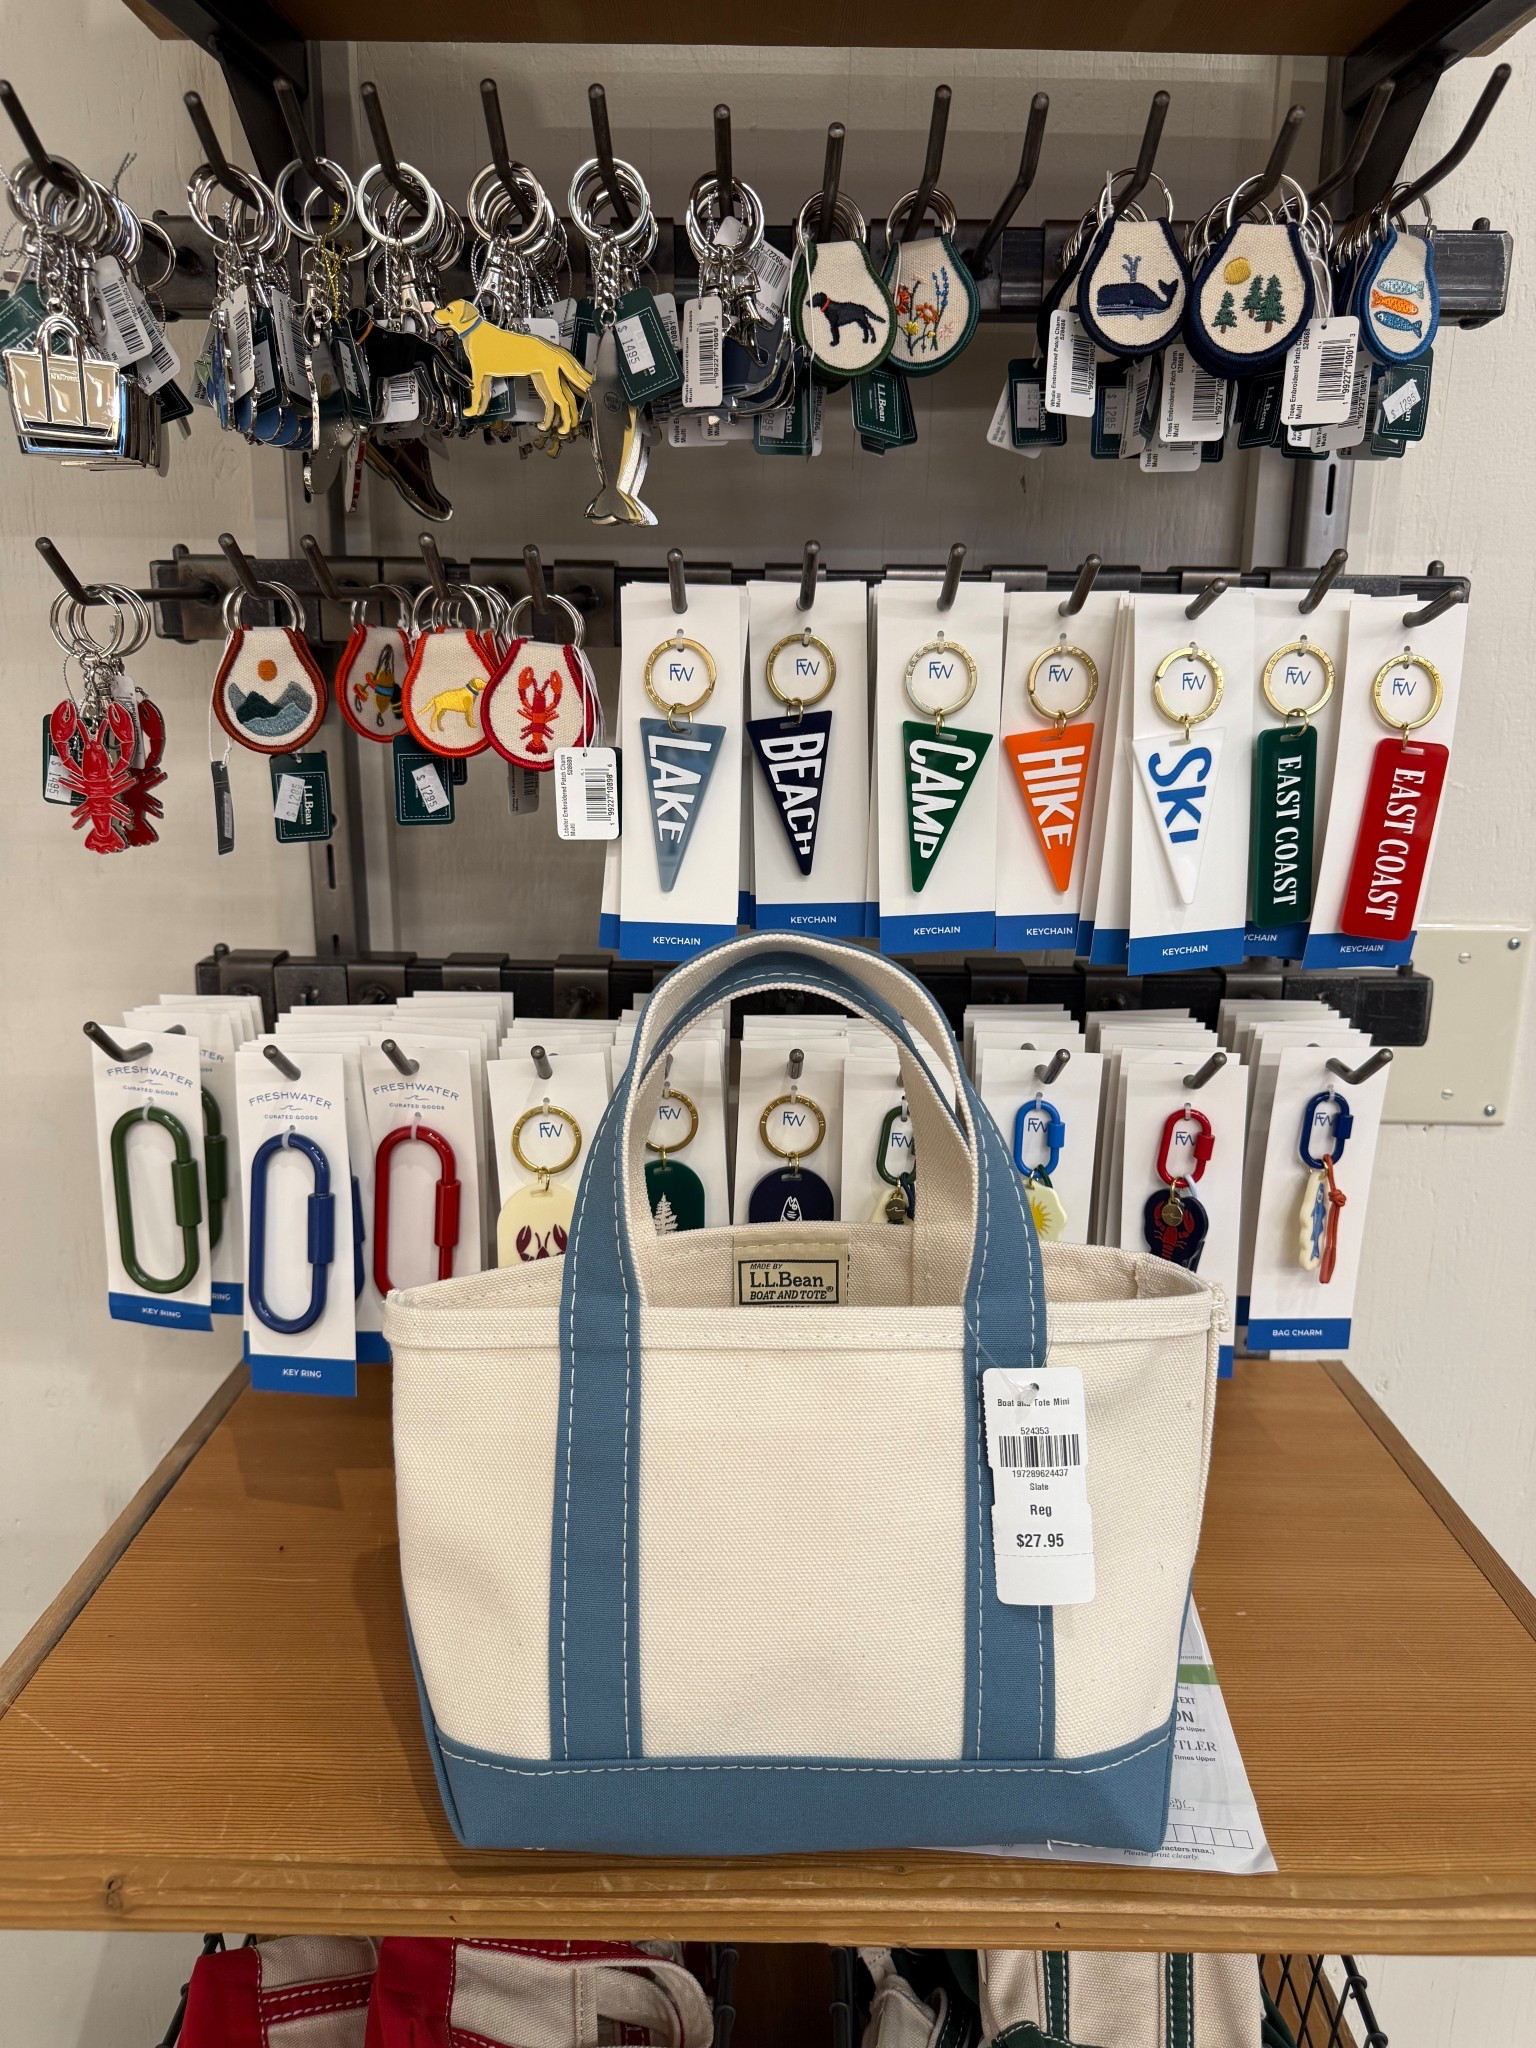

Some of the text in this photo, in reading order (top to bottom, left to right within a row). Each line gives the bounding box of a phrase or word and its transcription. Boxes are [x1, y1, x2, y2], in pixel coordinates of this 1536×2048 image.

[766, 248, 784, 266] 99227
[620, 338, 642, 366] 1495
[1346, 345, 1354, 369] 10901
[1051, 353, 1059, 388] Embroidered
[1087, 367, 1095, 390] 99227
[1290, 365, 1300, 402] Embroidered
[1342, 370, 1352, 394] 99227
[877, 382, 888, 423] L.L.Bean
[1167, 387, 1175, 421] Embroidered
[1215, 393, 1223, 415] 99227
[1287, 403, 1295, 420] Trees
[1295, 404, 1303, 419] Multi
[1356, 397, 1365, 419] 99227
[1400, 392, 1417, 413] 1295
[1105, 405, 1118, 429] 1295
[669, 663, 694, 682] FW
[796, 659, 820, 676] FW
[928, 661, 954, 679] FW
[1048, 664, 1074, 683] FW
[1284, 666, 1311, 685] FW
[1181, 672, 1206, 691] FW
[1392, 678, 1417, 697] FW
[416, 774, 439, 809] $ 1295
[648, 735, 712, 844] LAKE
[760, 733, 824, 855] BEACH
[1017, 745, 1085, 850] HIKE
[1148, 746, 1212, 844] SKI
[304, 785, 313, 825] L.L.Bean
[909, 740, 977, 859] CAMP
[1273, 755, 1302, 905] EAST COAST
[1365, 767, 1426, 921] EAST COAST
[790, 915, 837, 925] KEYCHAIN
[913, 925, 961, 936] KEYCHAIN
[1026, 926, 1073, 937] KEYCHAIN
[1243, 933, 1278, 943] YCHAIN
[652, 936, 701, 946] KEYCHAIN
[1162, 944, 1208, 956] KEYCHAIN
[1340, 944, 1384, 954] KEYCHAIN
[107, 1065, 194, 1088] FRESHWATER
[122, 1085, 154, 1094] CURATED
[373, 1082, 459, 1101] FRESHWATER
[248, 1091, 332, 1110] FRESHWATER
[658, 1105, 682, 1120] FW
[782, 1111, 806, 1127] FW
[539, 1122, 564, 1138] FW
[749, 1271, 824, 1288] L.L.Bean
[211, 1293, 231, 1301] RING
[750, 1290, 776, 1300] BOAT
[776, 1291, 799, 1300] AND
[141, 1307, 182, 1318] KEY RING
[283, 1368, 322, 1379] KEY RING
[997, 1397, 1070, 1407] Boat Tote Mini
[1020, 1427, 1050, 1435] 524353
[1011, 1468, 1069, 1478] 197289624437
[1029, 1482, 1049, 1491] Slate
[1030, 1504, 1052, 1517] Reg
[1016, 1533, 1064, 1549] $27.95
[1174, 1739, 1218, 1752] TLER
[1195, 1755, 1217, 1763] Upper
[1123, 1849, 1149, 1857] Please
[1171, 1853, 1200, 1861] clearly.
[1191, 1847, 1215, 1855] max.)
